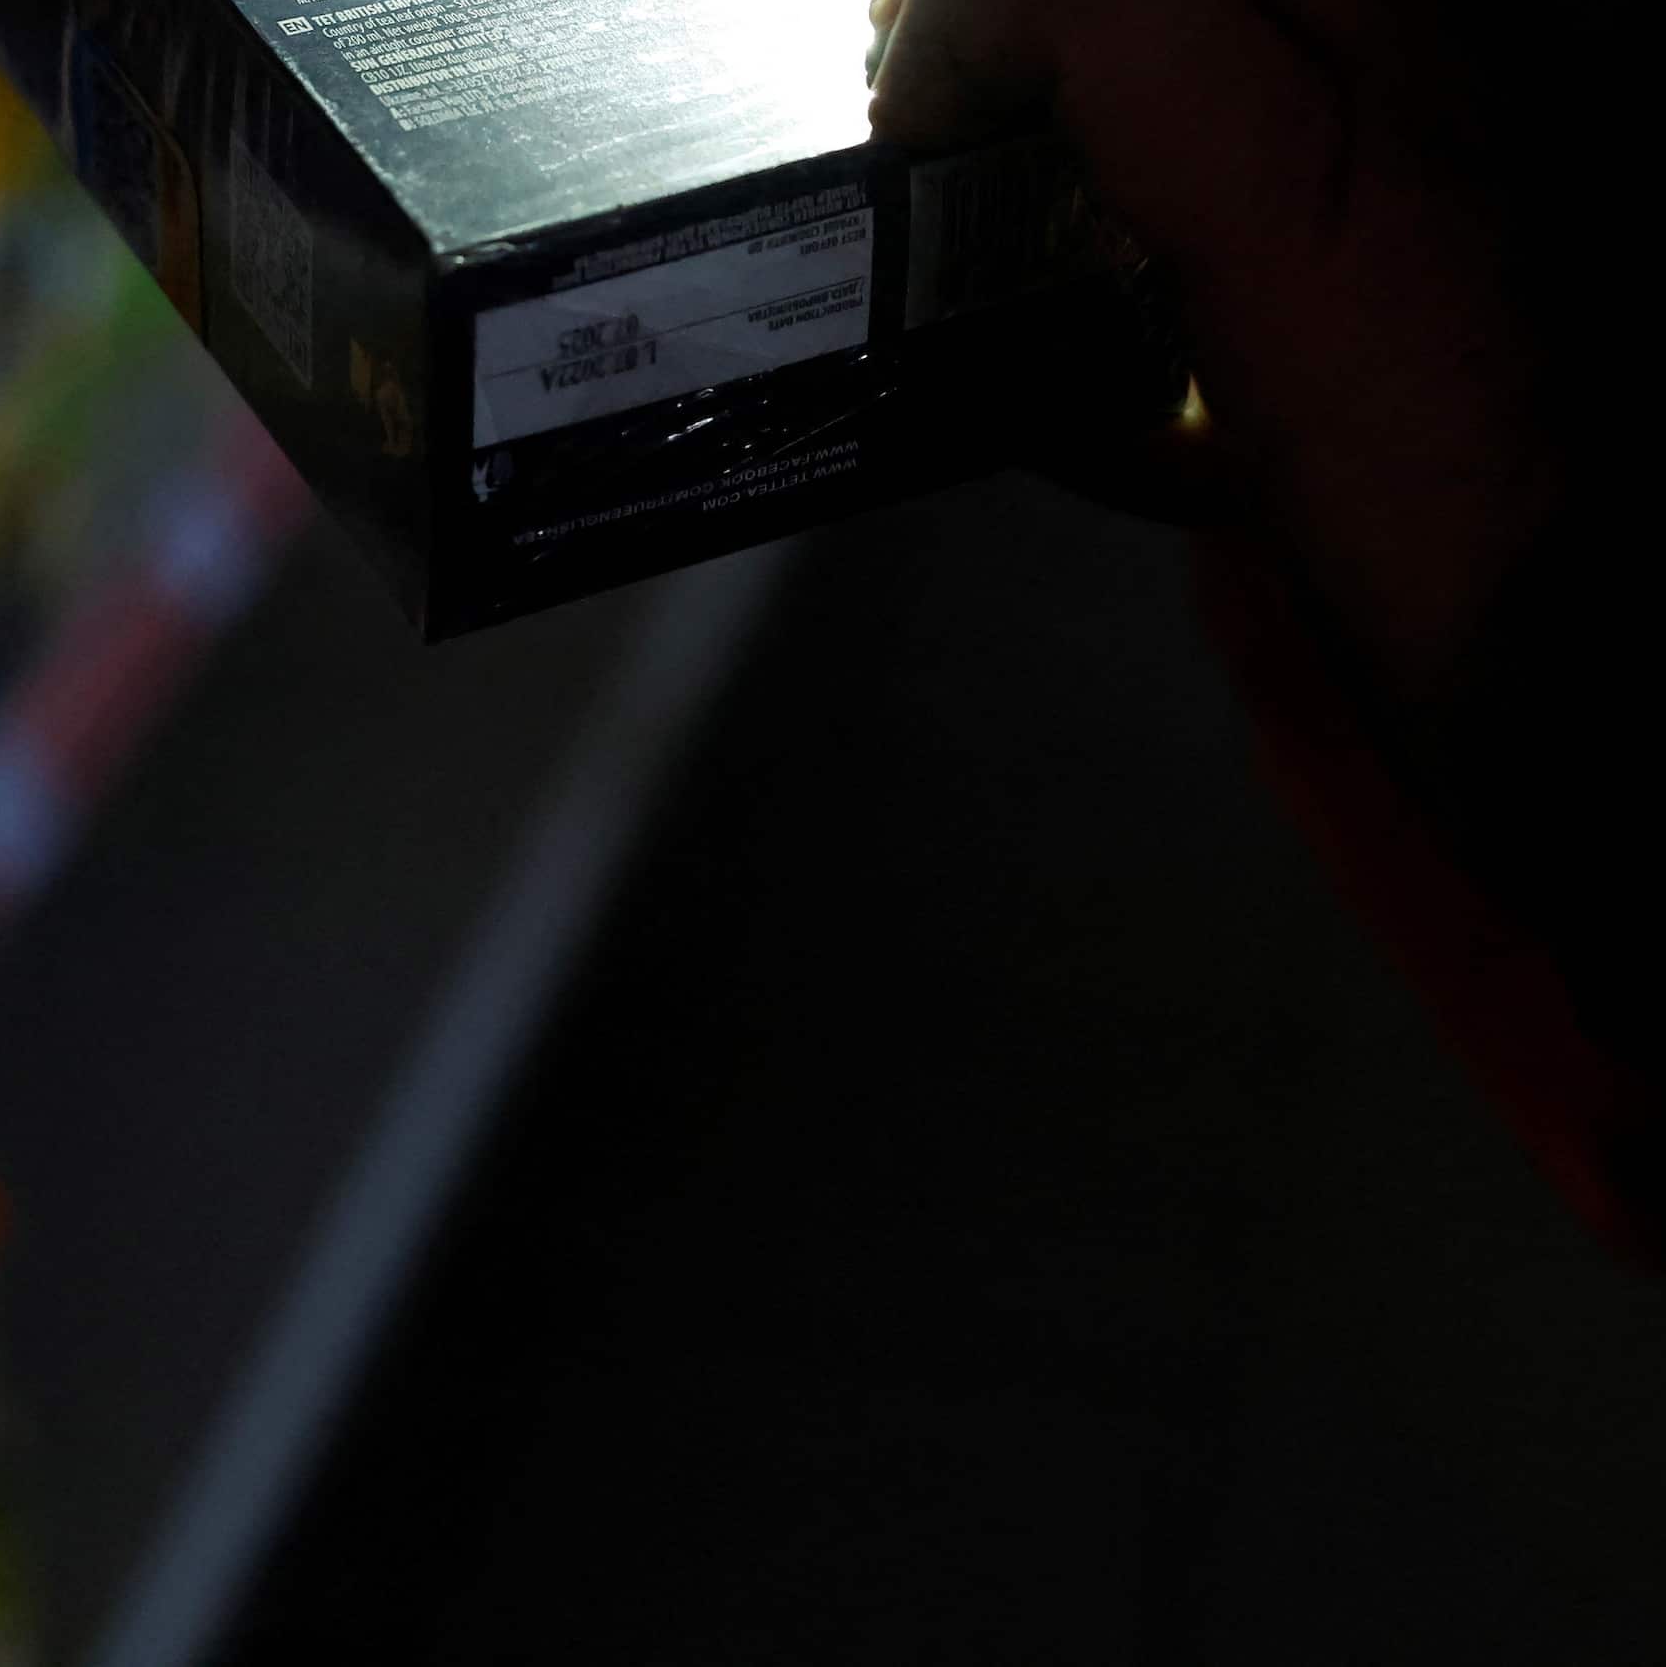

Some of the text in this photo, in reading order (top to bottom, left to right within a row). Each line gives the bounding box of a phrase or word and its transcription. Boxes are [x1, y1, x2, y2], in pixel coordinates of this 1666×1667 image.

[279, 18, 309, 34] EN
[308, 11, 339, 27] TET
[332, 0, 388, 22] BRITISH
[319, 19, 369, 40] Country
[360, 16, 380, 31] of
[371, 12, 398, 29] tea
[390, 8, 419, 25] leaf
[410, 1, 449, 20] origin
[328, 36, 350, 51] of
[380, 24, 407, 39] Net
[398, 16, 445, 36] weight
[338, 48, 358, 62] in
[349, 45, 373, 59] an
[364, 36, 412, 56] airtight
[404, 26, 460, 47] container
[451, 20, 488, 37] away
[347, 55, 381, 73] SUN
[374, 39, 457, 67] GENERATION
[357, 67, 393, 85] CB10
[406, 55, 450, 74] United
[366, 66, 455, 96] DISTRIBUTOR
[447, 63, 471, 79] IN
